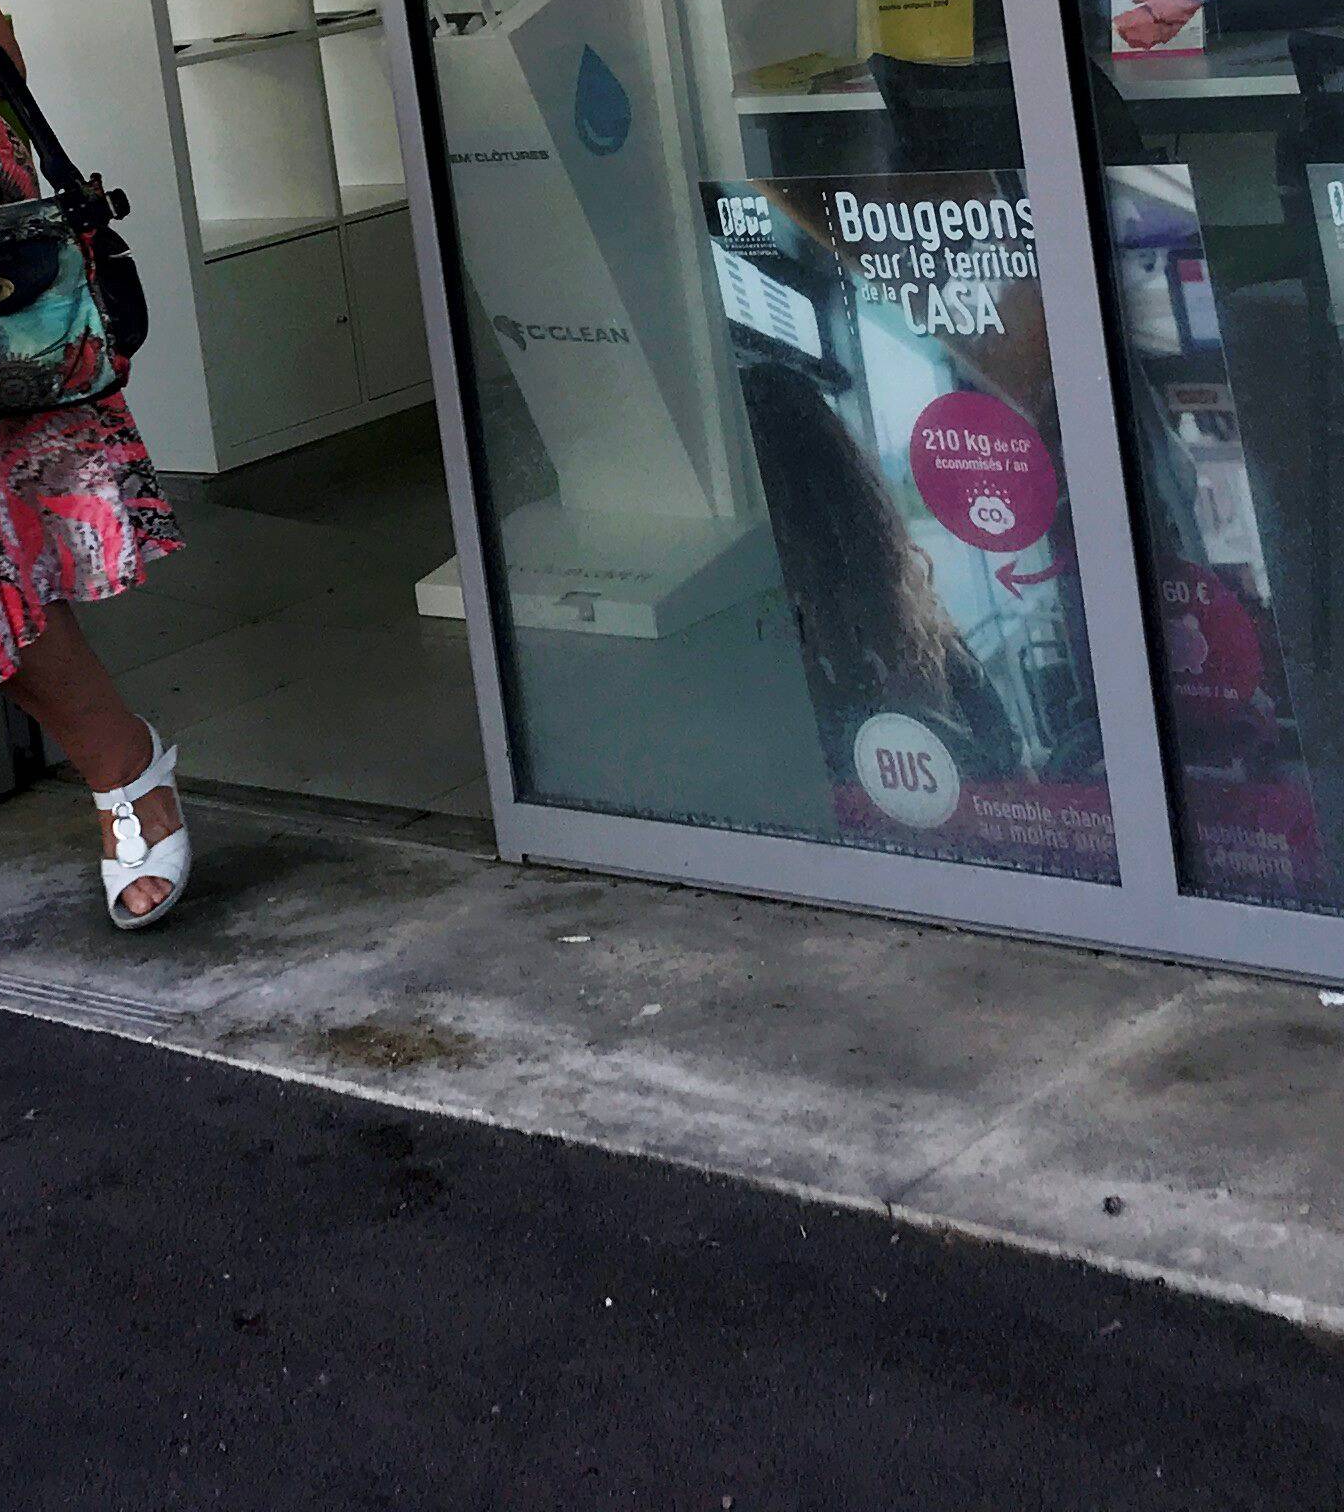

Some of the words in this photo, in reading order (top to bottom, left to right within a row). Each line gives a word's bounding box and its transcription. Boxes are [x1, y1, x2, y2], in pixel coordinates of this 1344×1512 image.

[474, 149, 550, 162] CLÔTURES
[834, 191, 1036, 252] Bougeons
[860, 252, 901, 280] sur
[909, 244, 936, 279] le
[861, 283, 879, 301] de
[882, 282, 897, 302] la
[900, 282, 1006, 335] CASA
[921, 428, 961, 451] 210
[963, 429, 992, 457] kg
[994, 438, 1009, 453] de
[935, 455, 1004, 471] économisés
[1013, 460, 1029, 473] an
[875, 748, 938, 794] BUS
